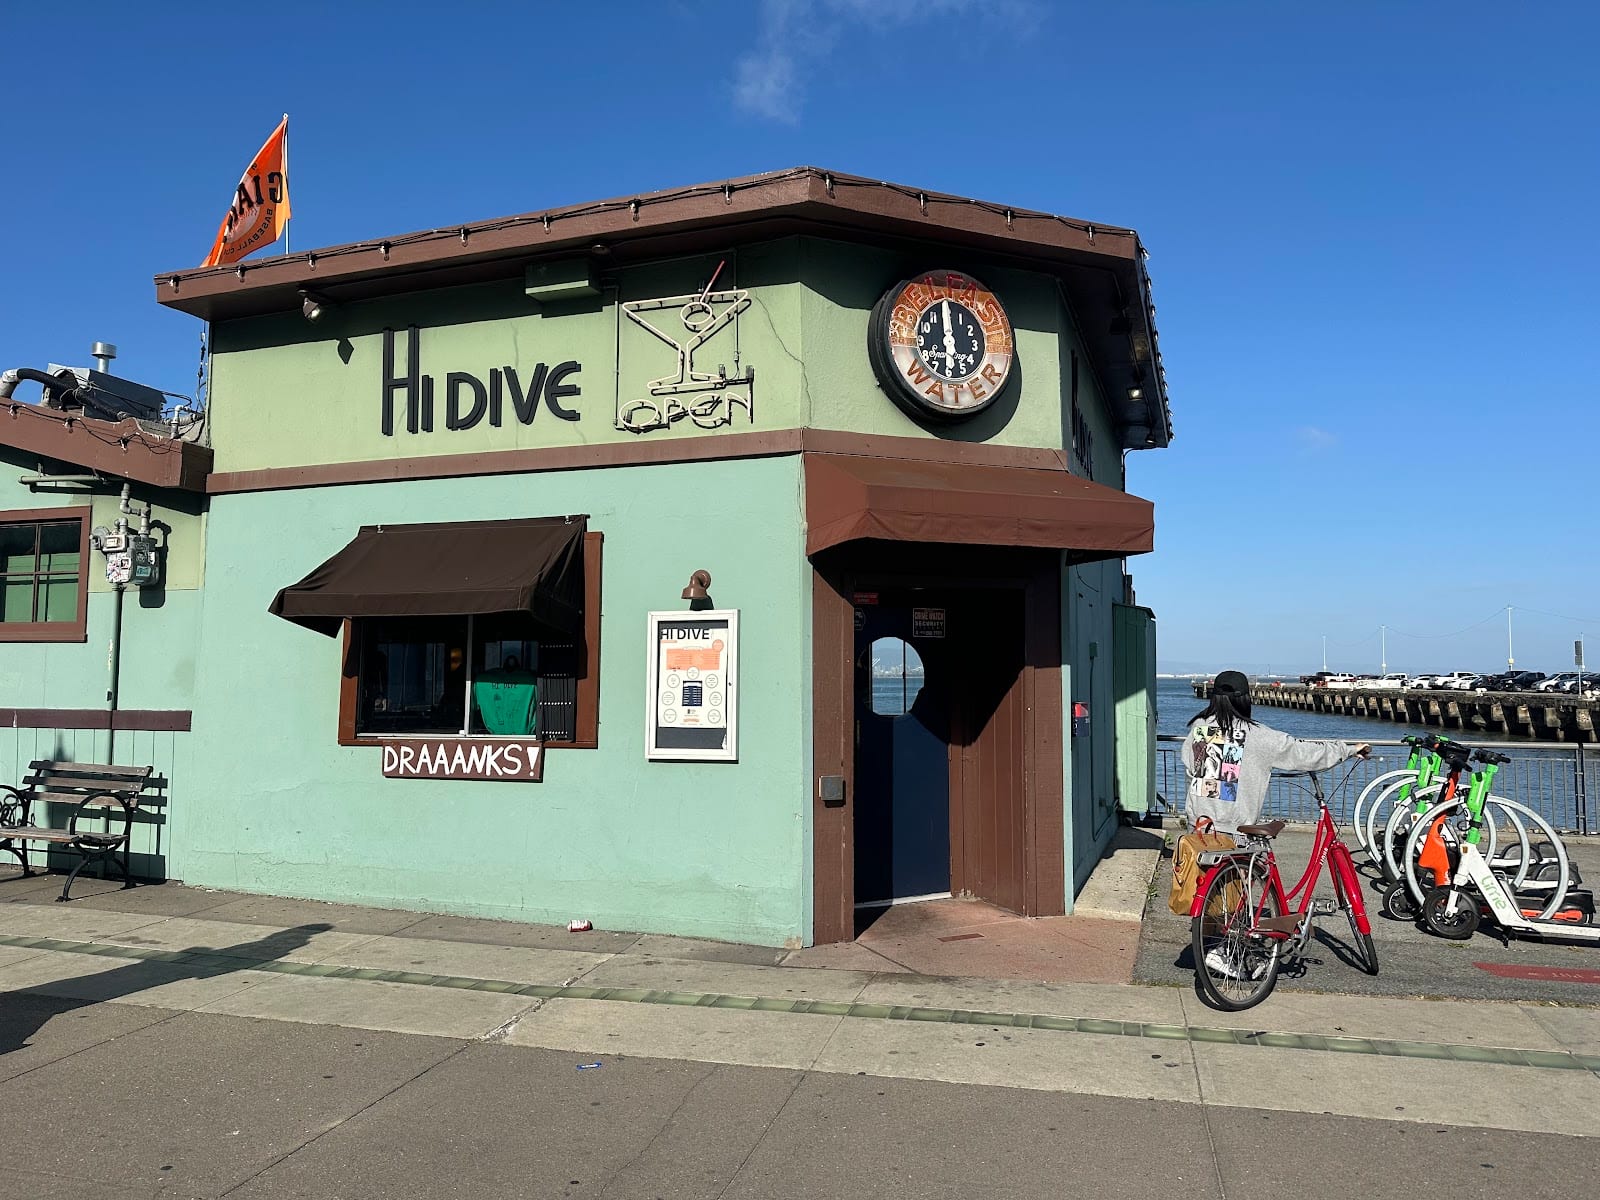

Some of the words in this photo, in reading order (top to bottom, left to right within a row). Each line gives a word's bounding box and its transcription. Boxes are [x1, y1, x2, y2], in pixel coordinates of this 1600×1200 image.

[892, 273, 1011, 342] BELFAST
[920, 321, 931, 334] 10
[967, 324, 974, 337] 2
[917, 334, 925, 347] 9
[971, 339, 979, 351] 3
[922, 349, 930, 361] 8
[966, 353, 975, 365] 4
[931, 360, 939, 371] 7
[959, 362, 966, 374] 5
[945, 366, 952, 378] 6
[906, 358, 1002, 404] WATER
[446, 361, 582, 431] DIVE
[659, 628, 673, 640] HI
[676, 628, 710, 640] DIVE
[383, 743, 540, 776] DRAAANKS!
